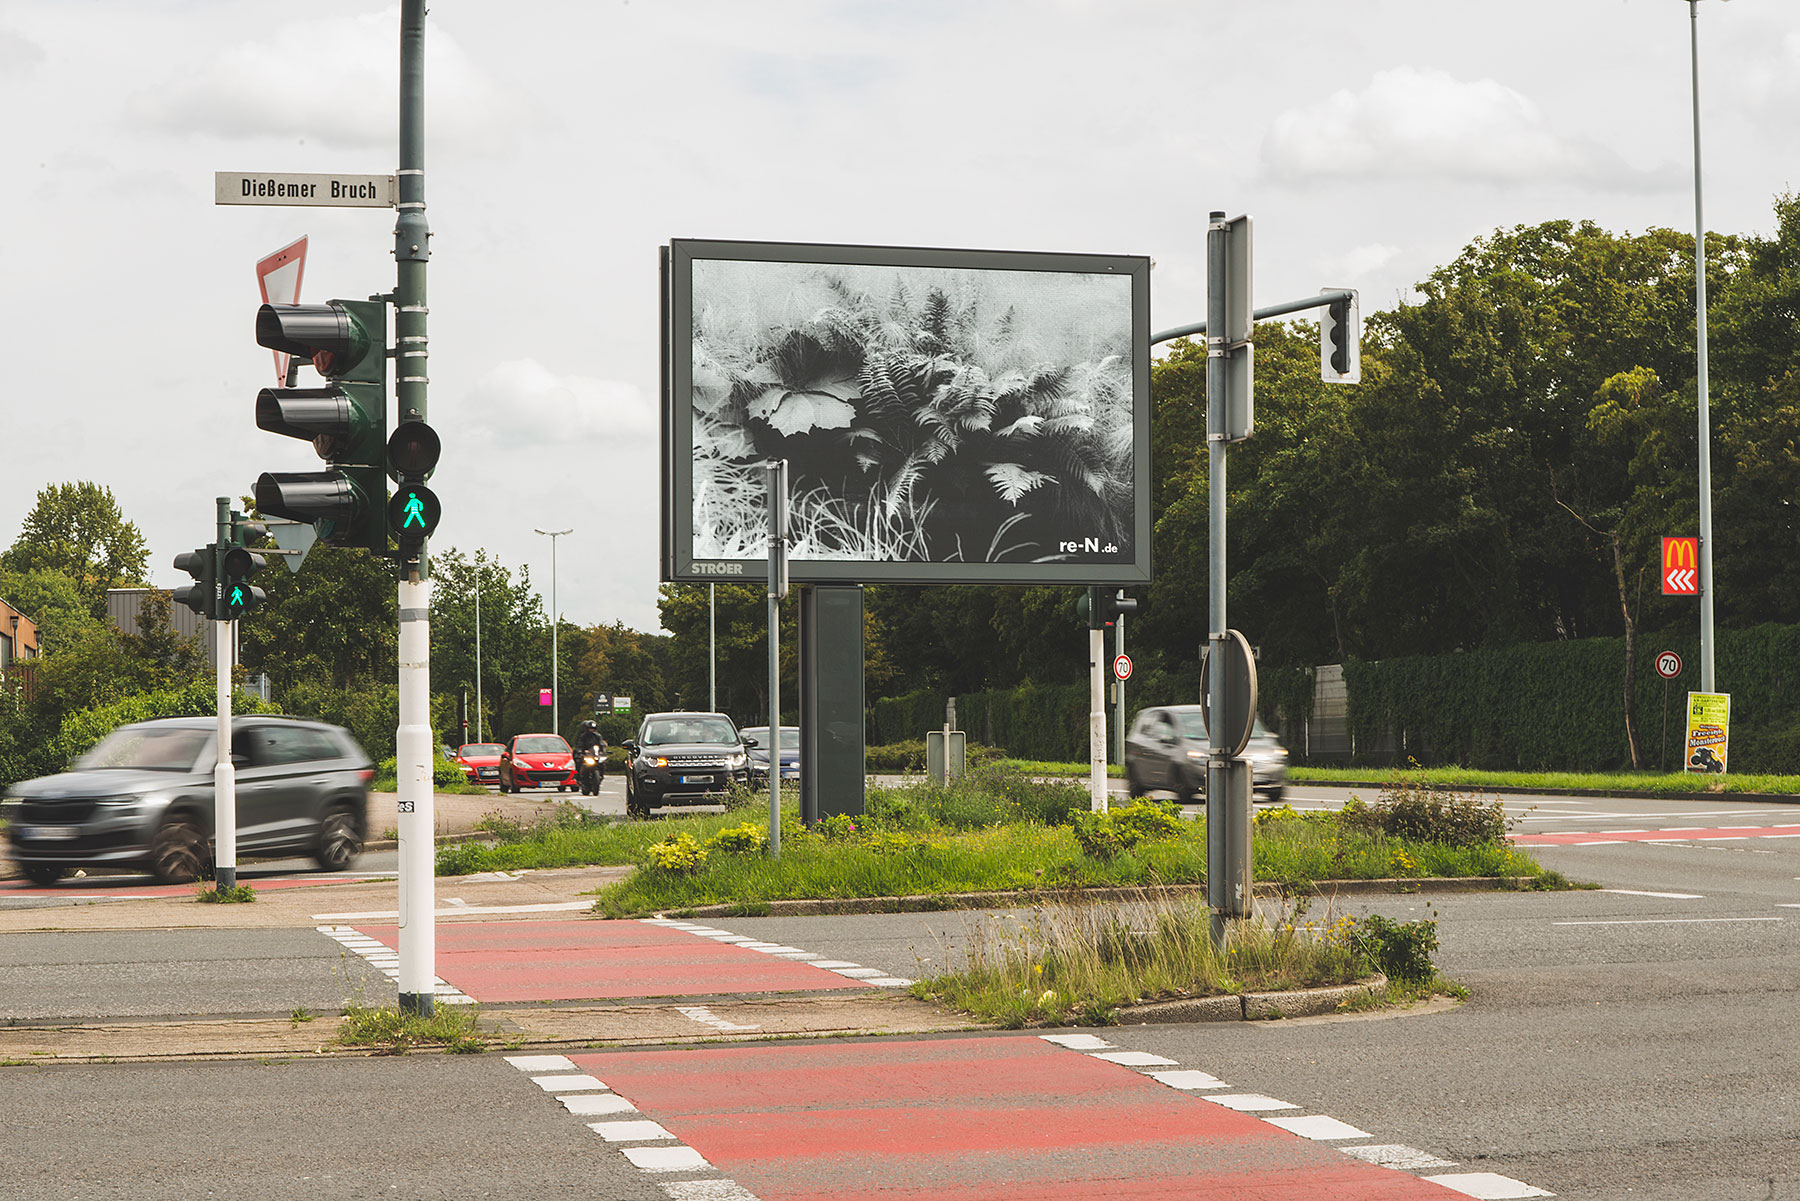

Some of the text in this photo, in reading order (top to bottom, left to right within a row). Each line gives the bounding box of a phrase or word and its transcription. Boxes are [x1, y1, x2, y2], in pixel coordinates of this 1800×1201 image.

[242, 179, 376, 199] Dießemer Bruch
[691, 562, 743, 574] STRÖER
[1118, 662, 1128, 673] 70
[1661, 658, 1676, 672] 70
